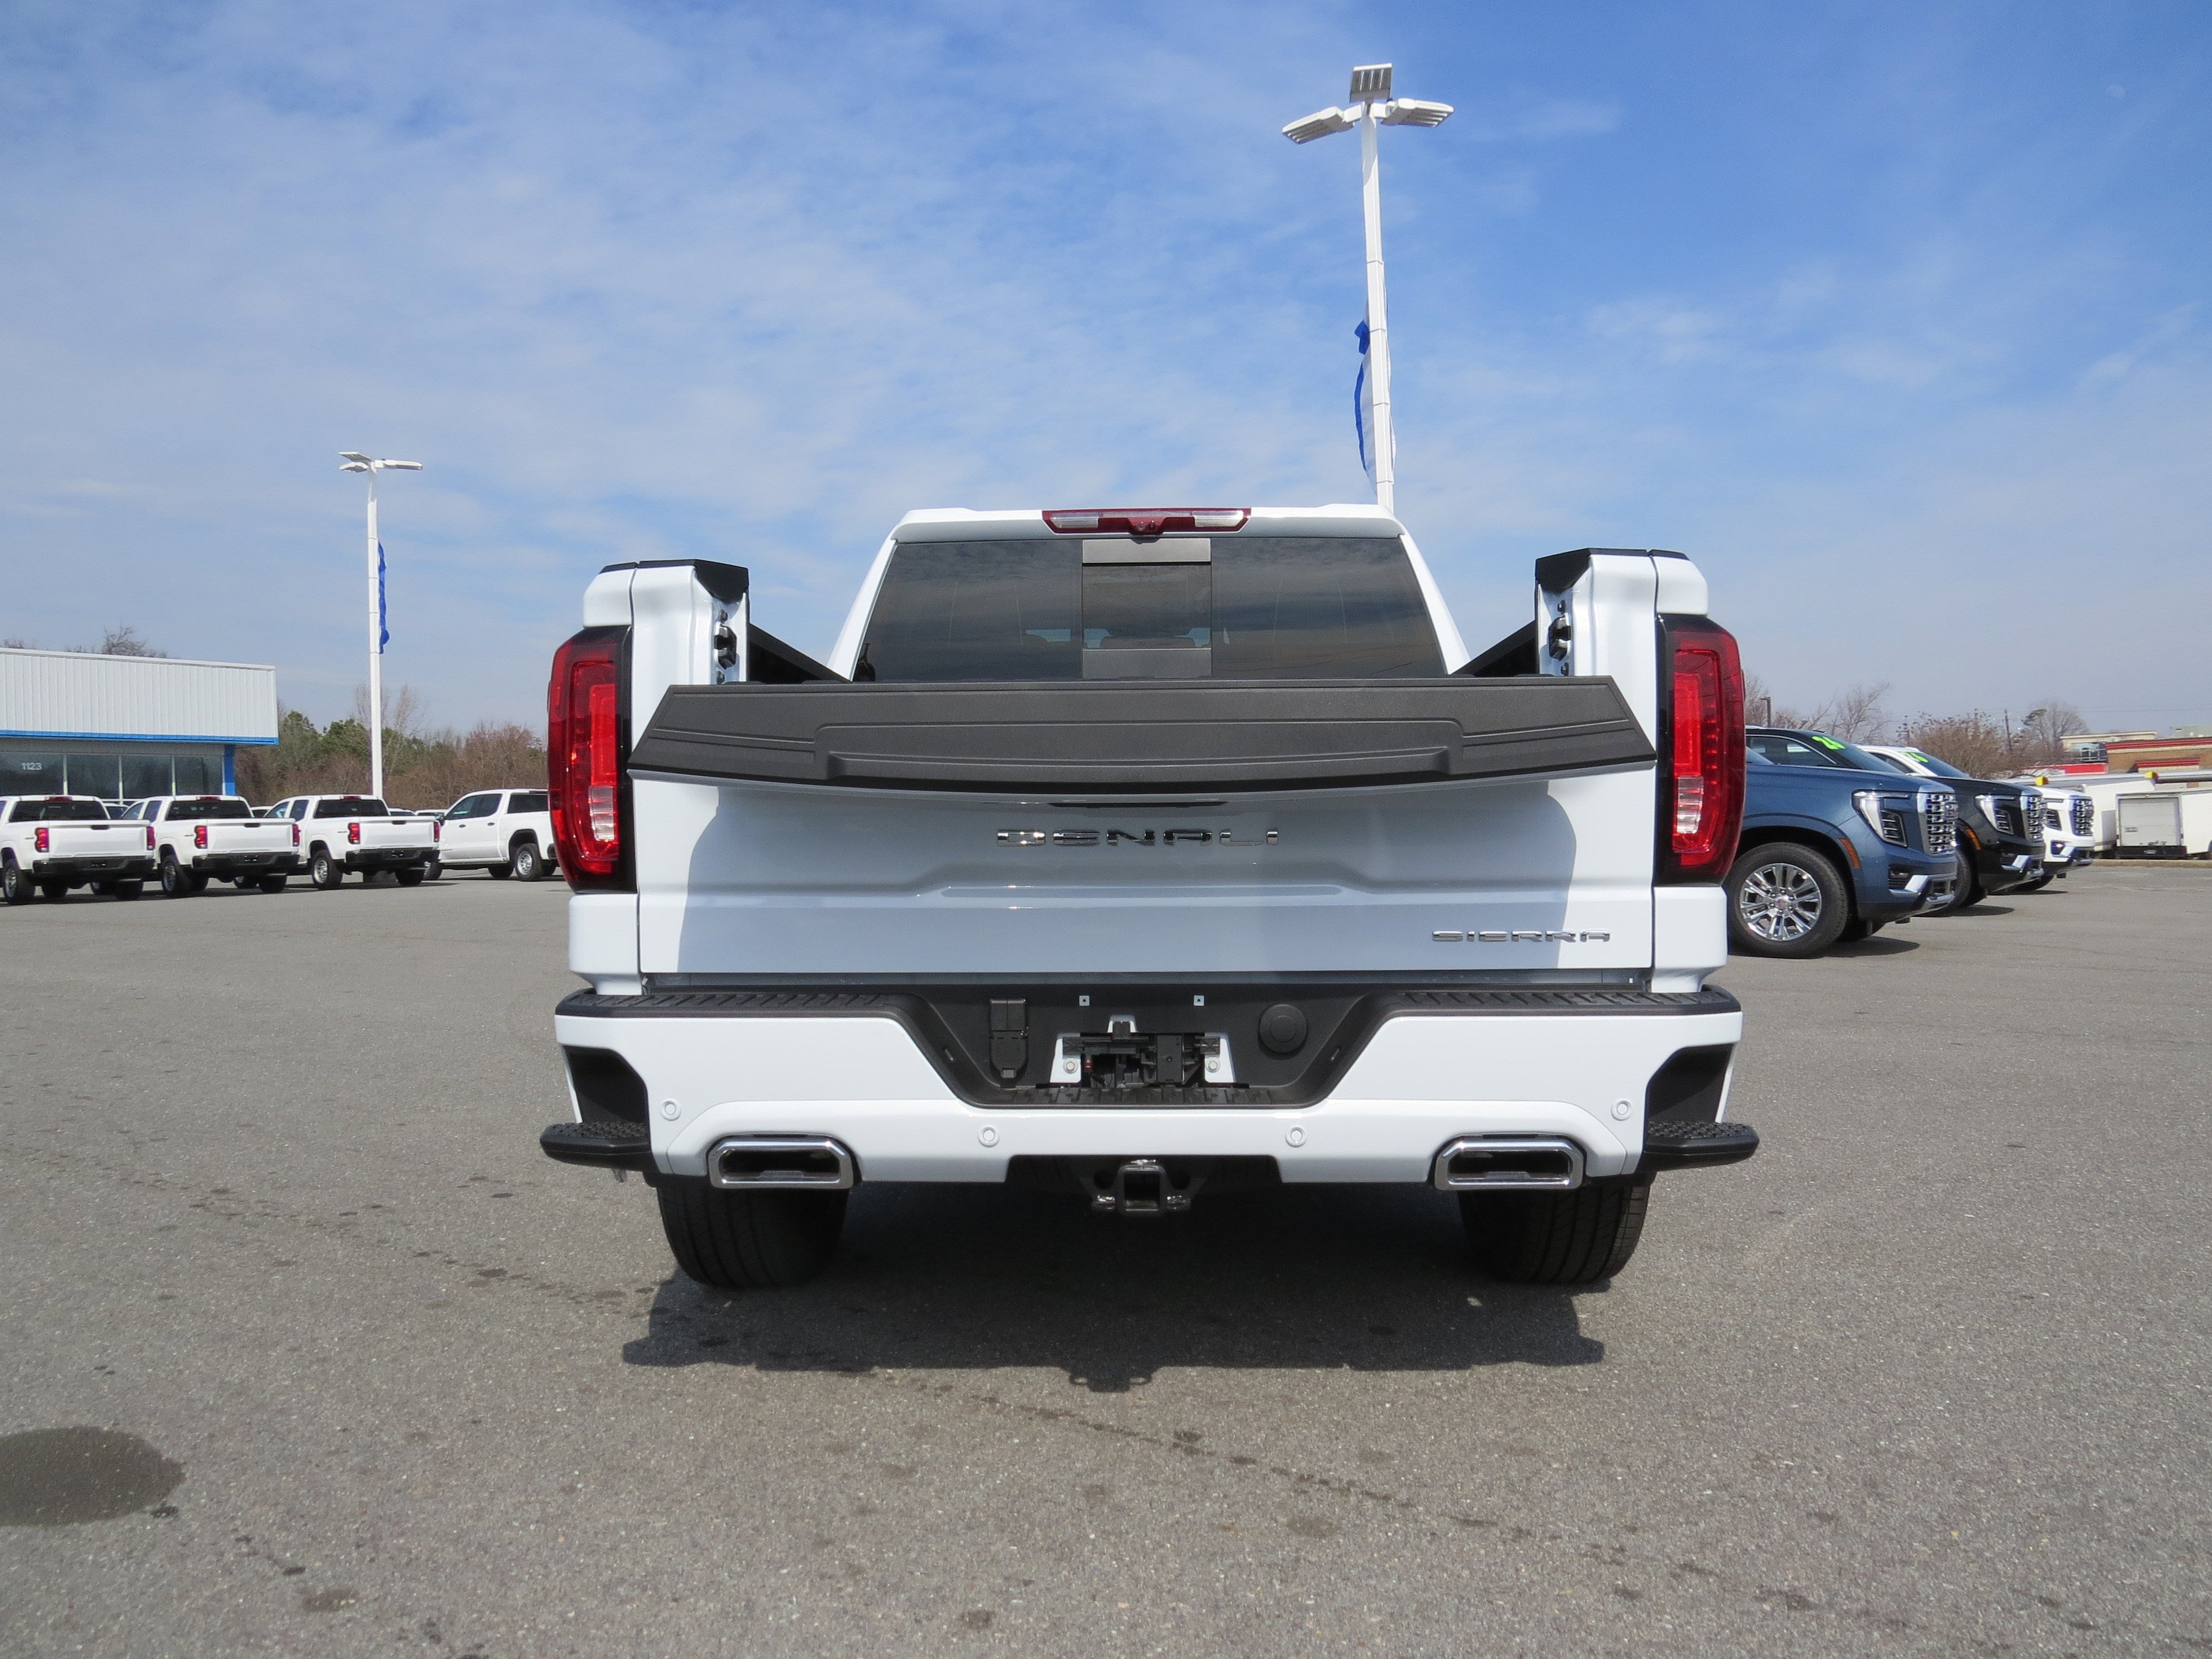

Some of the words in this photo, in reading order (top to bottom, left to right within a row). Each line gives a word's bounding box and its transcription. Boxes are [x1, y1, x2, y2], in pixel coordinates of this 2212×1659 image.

[21, 762, 43, 771] 1123
[997, 829, 1278, 846] DENALI
[1432, 930, 1611, 942] SIERRA
